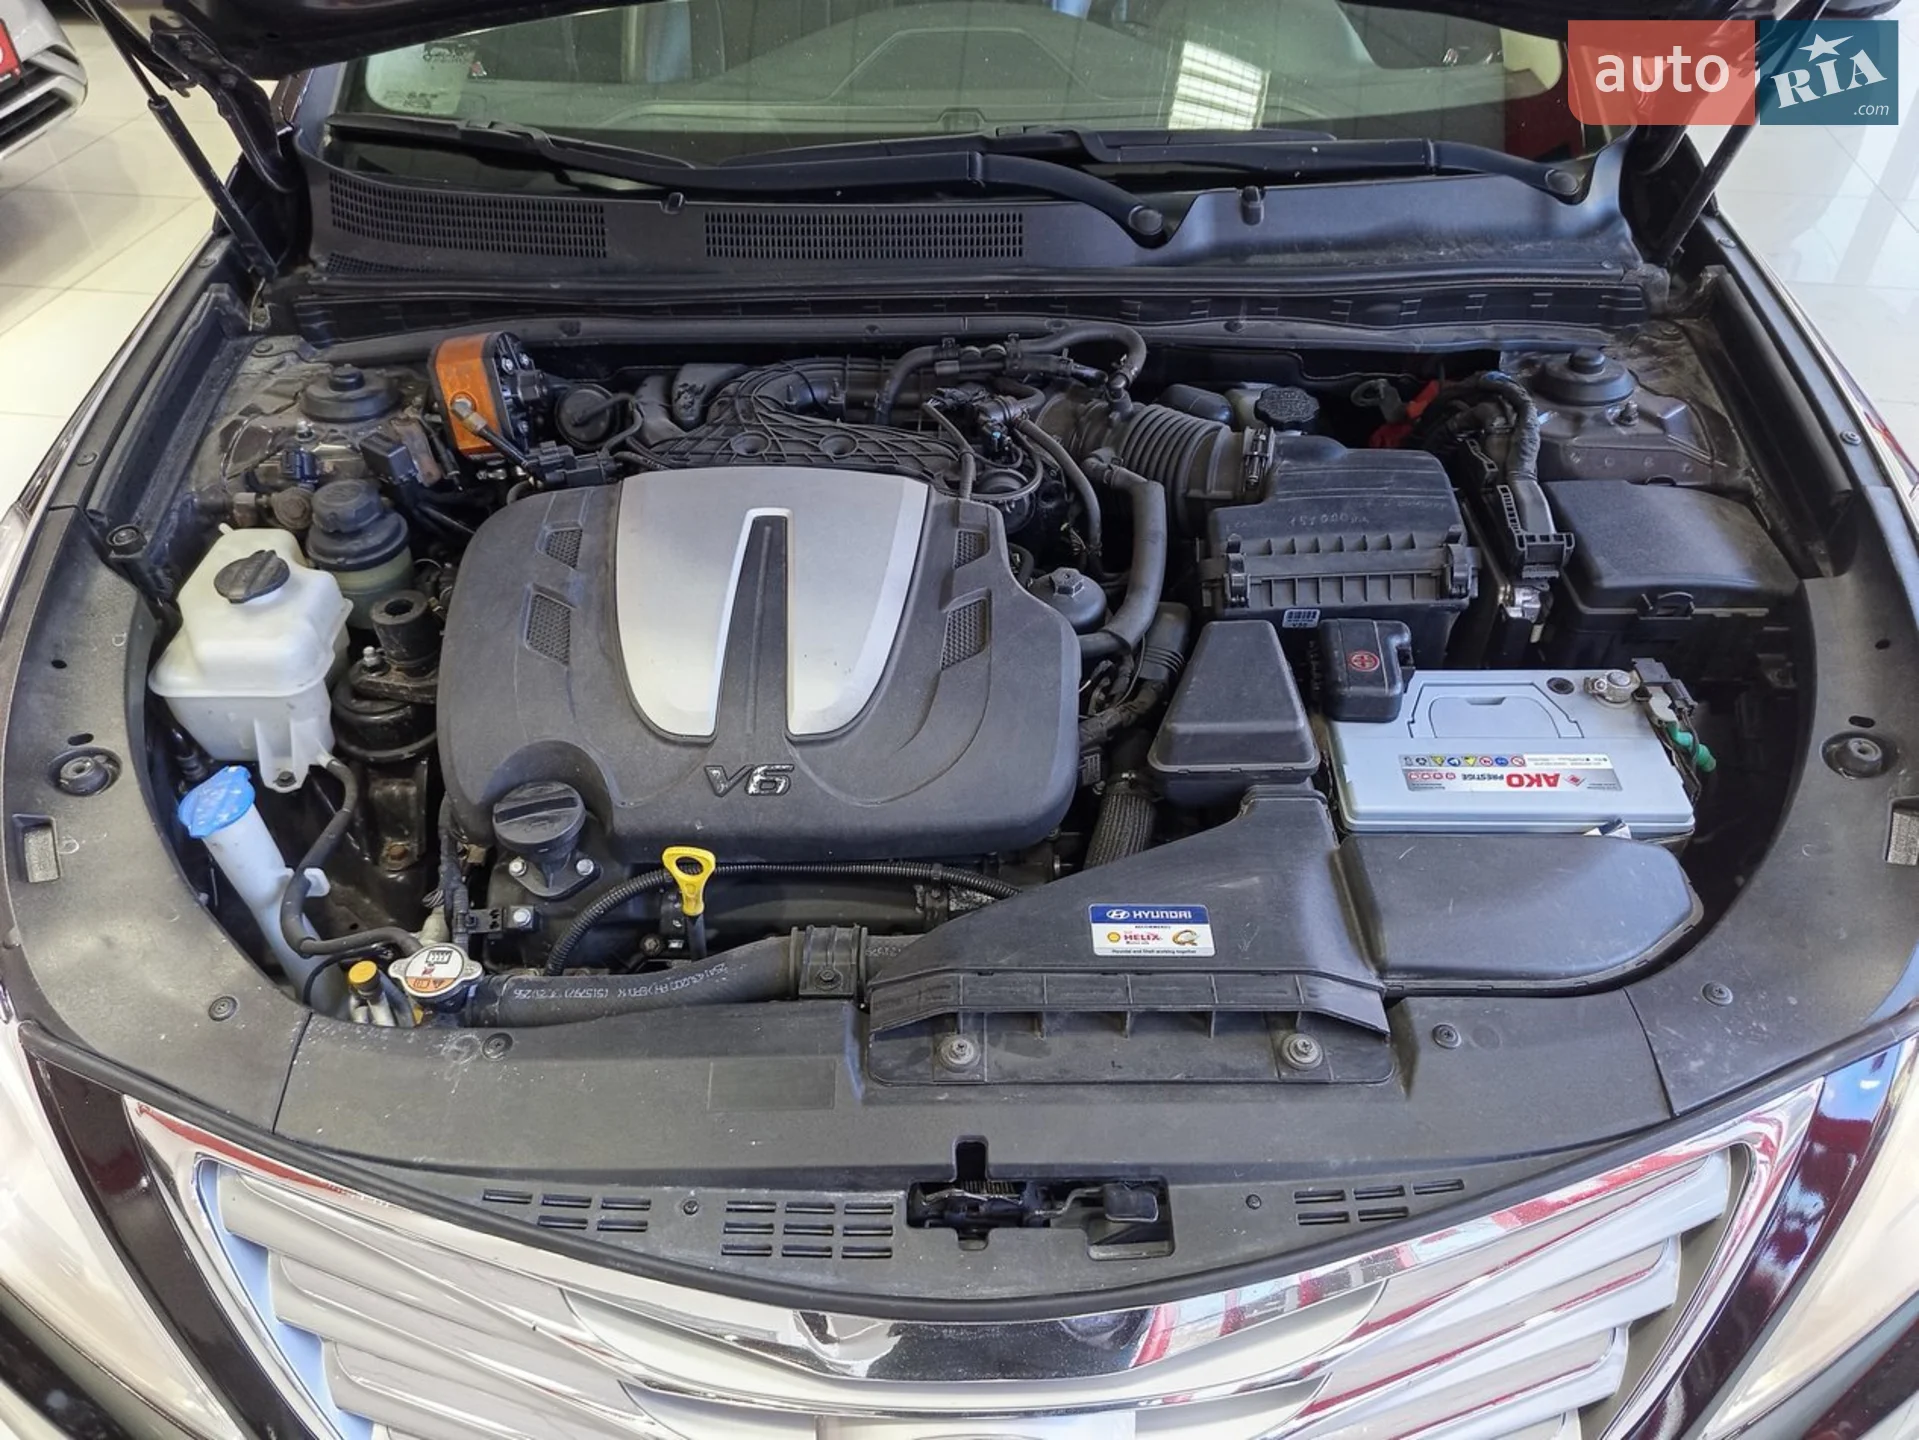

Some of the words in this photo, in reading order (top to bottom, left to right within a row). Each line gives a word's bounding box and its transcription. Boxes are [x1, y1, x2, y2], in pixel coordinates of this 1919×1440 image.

[703, 763, 795, 798] V6
[1461, 774, 1505, 782] PRESTIGE
[1506, 773, 1561, 788] AKO
[1132, 910, 1192, 919] HYUNDAI
[1124, 932, 1160, 941] HELIX
